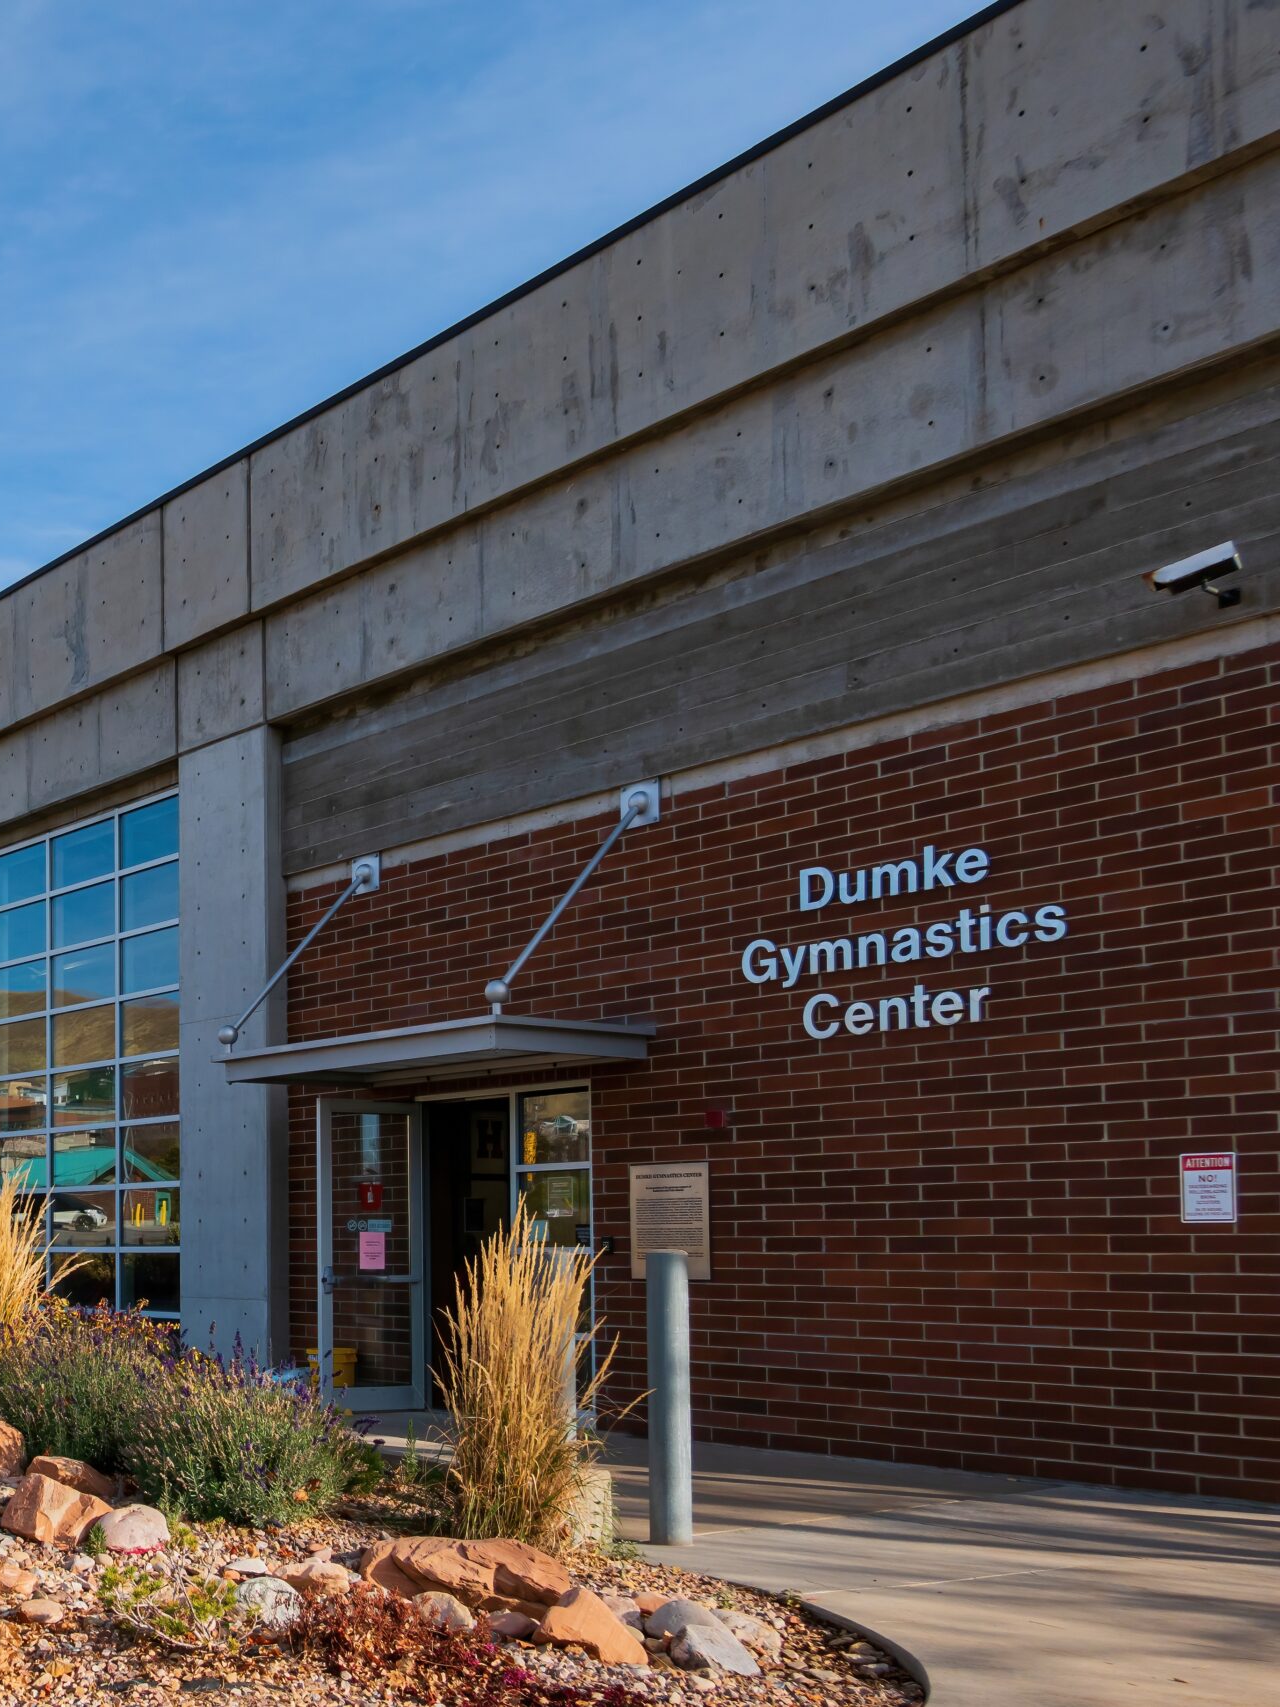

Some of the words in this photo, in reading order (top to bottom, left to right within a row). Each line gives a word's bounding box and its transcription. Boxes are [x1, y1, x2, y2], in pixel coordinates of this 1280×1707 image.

[799, 845, 991, 912] Dumke
[741, 904, 1068, 988] Gymnastics
[802, 984, 991, 1039] Center
[1186, 1157, 1230, 1168] ATTENTION
